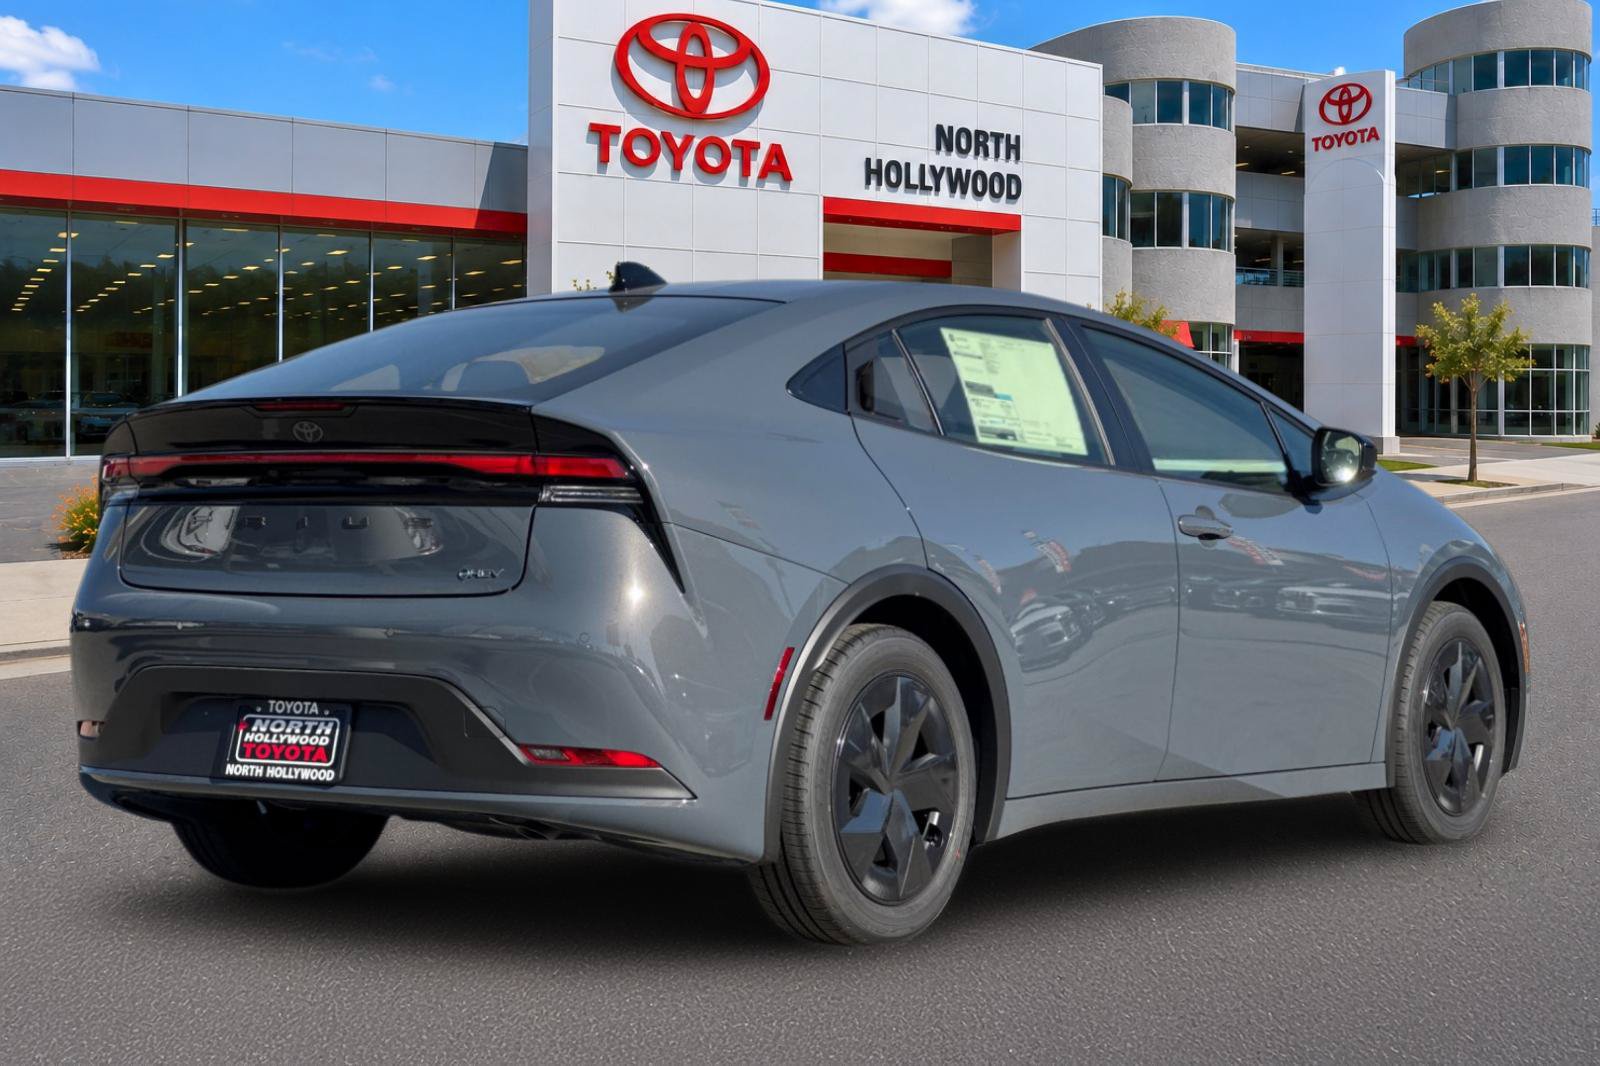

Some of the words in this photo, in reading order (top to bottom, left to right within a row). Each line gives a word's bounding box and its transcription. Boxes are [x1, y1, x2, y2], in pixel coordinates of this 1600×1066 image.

[935, 124, 1021, 162] NORTH
[1311, 126, 1380, 152] TOYOTA
[588, 122, 793, 182] TOYOTA
[864, 157, 1022, 202] HOLLYWOOD
[268, 700, 319, 715] TOYOTA
[251, 719, 334, 734] NORTH
[244, 732, 330, 746] HOLLYWOOD
[243, 742, 328, 762] TOYOTA
[225, 763, 263, 777] NORTH
[266, 766, 335, 781] HOLLYWOOD
